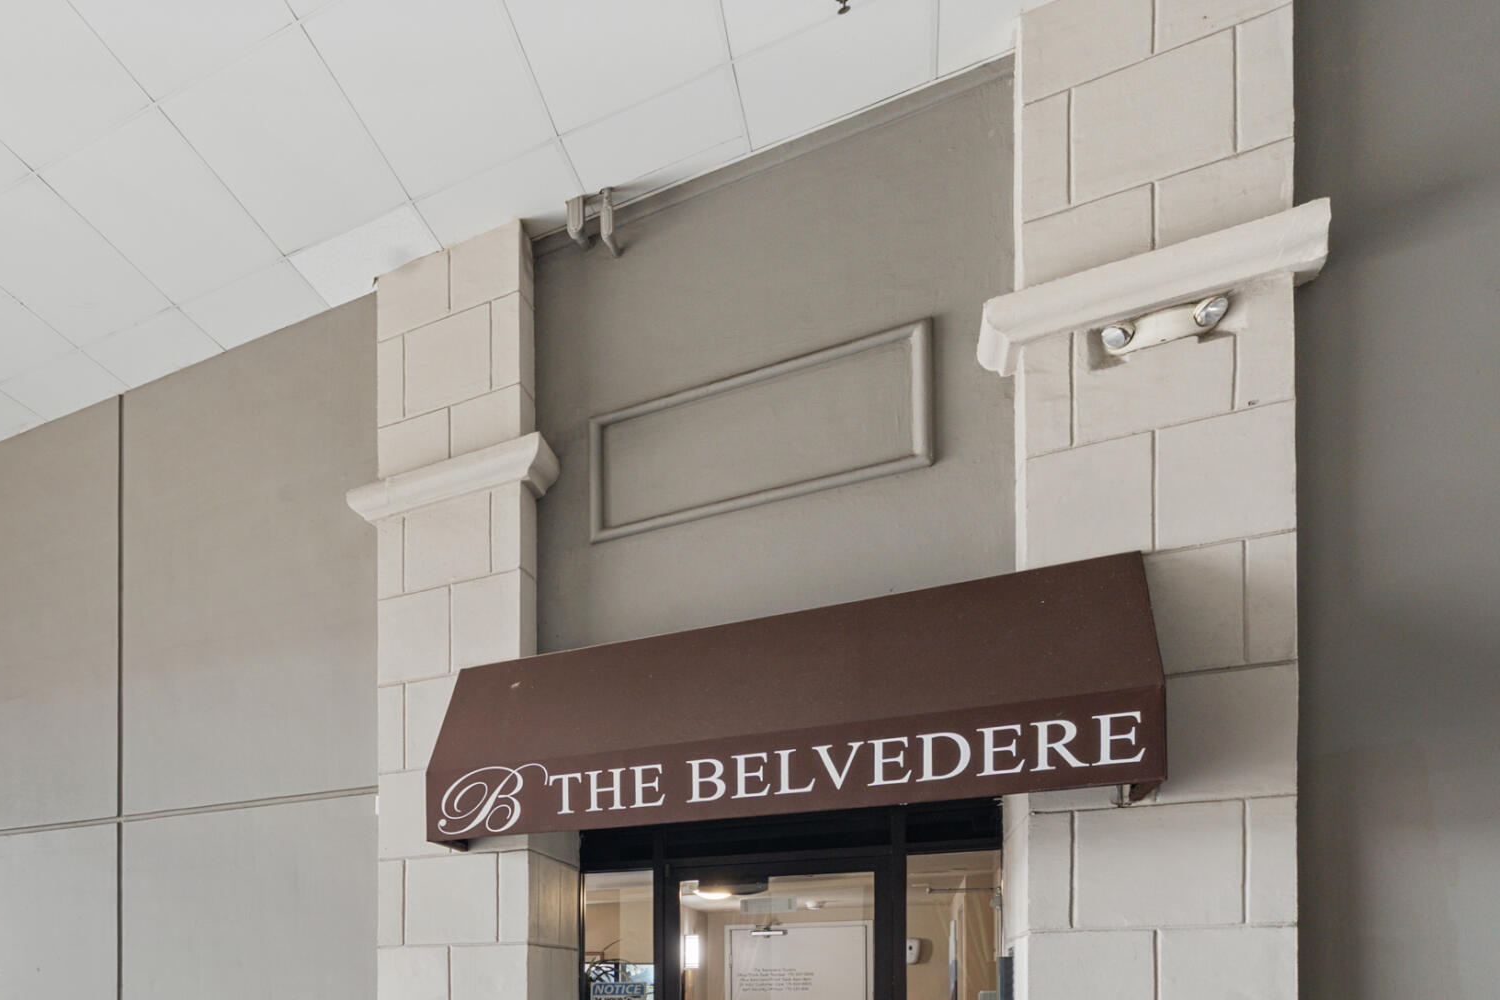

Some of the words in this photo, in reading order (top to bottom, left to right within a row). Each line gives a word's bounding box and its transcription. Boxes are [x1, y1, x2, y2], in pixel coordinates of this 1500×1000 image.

[548, 763, 666, 815] THE
[686, 711, 1146, 804] BELVEDERE
[595, 984, 642, 995] NOTICE
